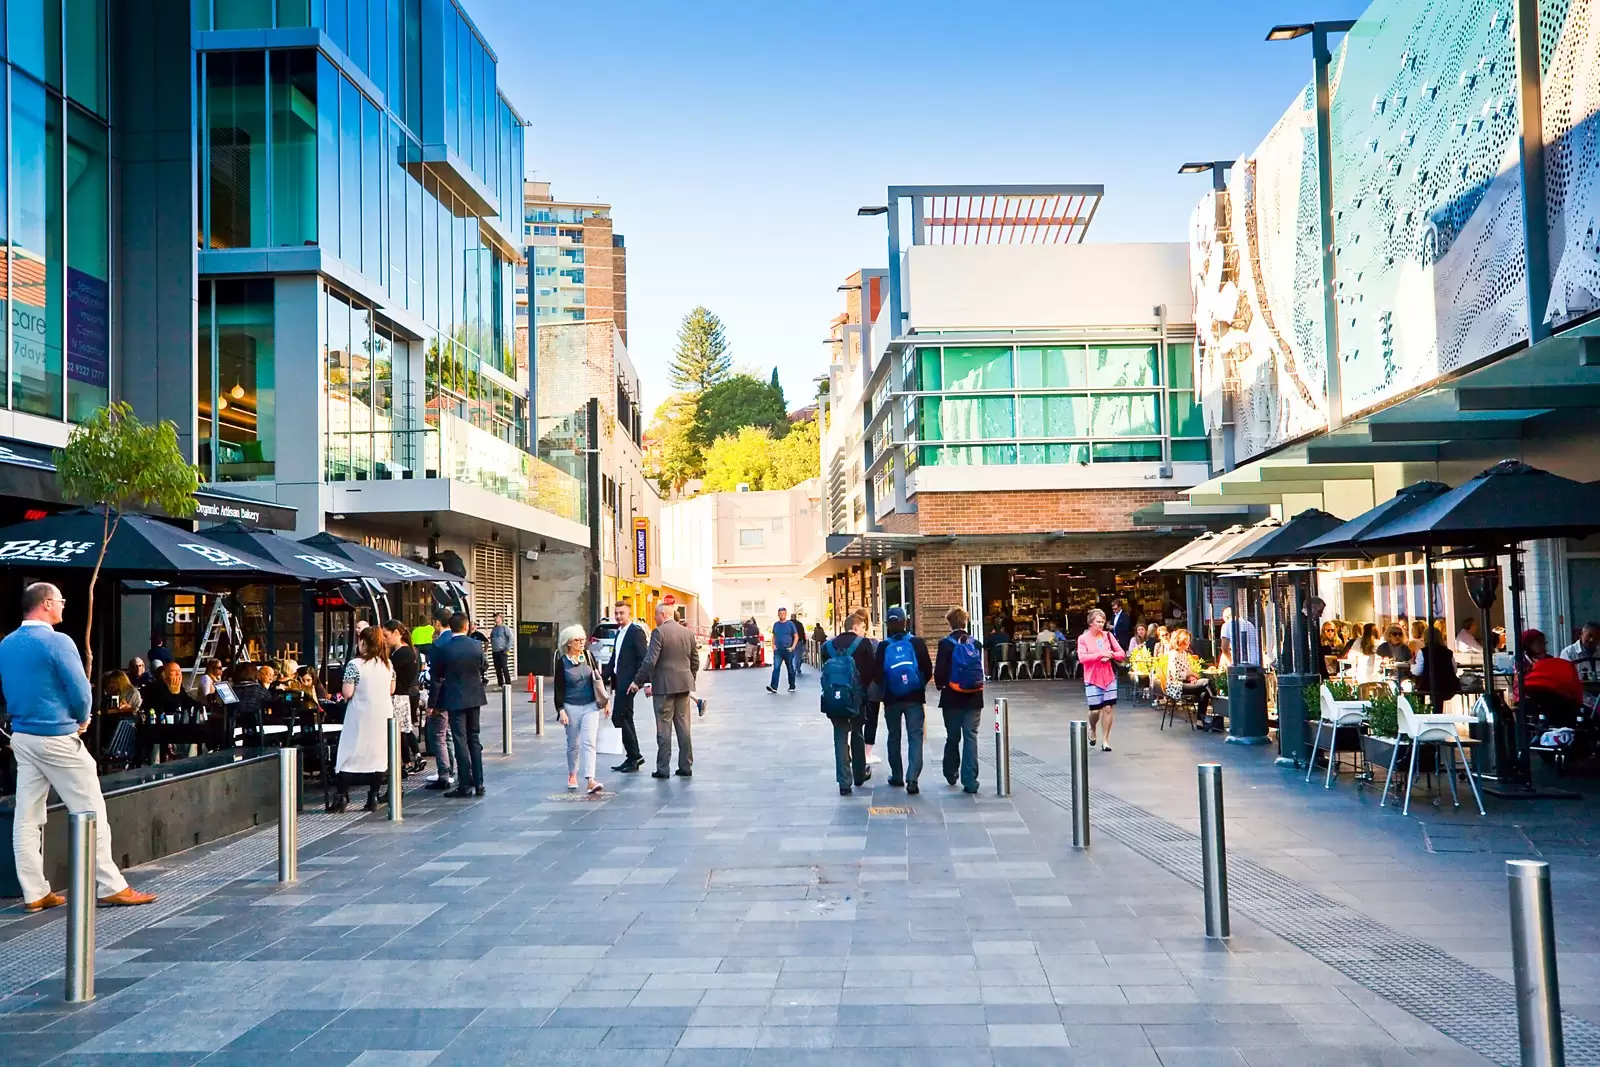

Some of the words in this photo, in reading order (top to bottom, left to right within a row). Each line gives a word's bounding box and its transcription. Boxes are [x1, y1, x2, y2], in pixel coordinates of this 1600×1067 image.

[12, 308, 46, 335] care
[196, 503, 219, 516] Organic
[220, 505, 240, 518] Artisan
[240, 508, 260, 522] Bakery
[637, 530, 645, 550] CHEMIST
[638, 549, 646, 573] DISCOUNT
